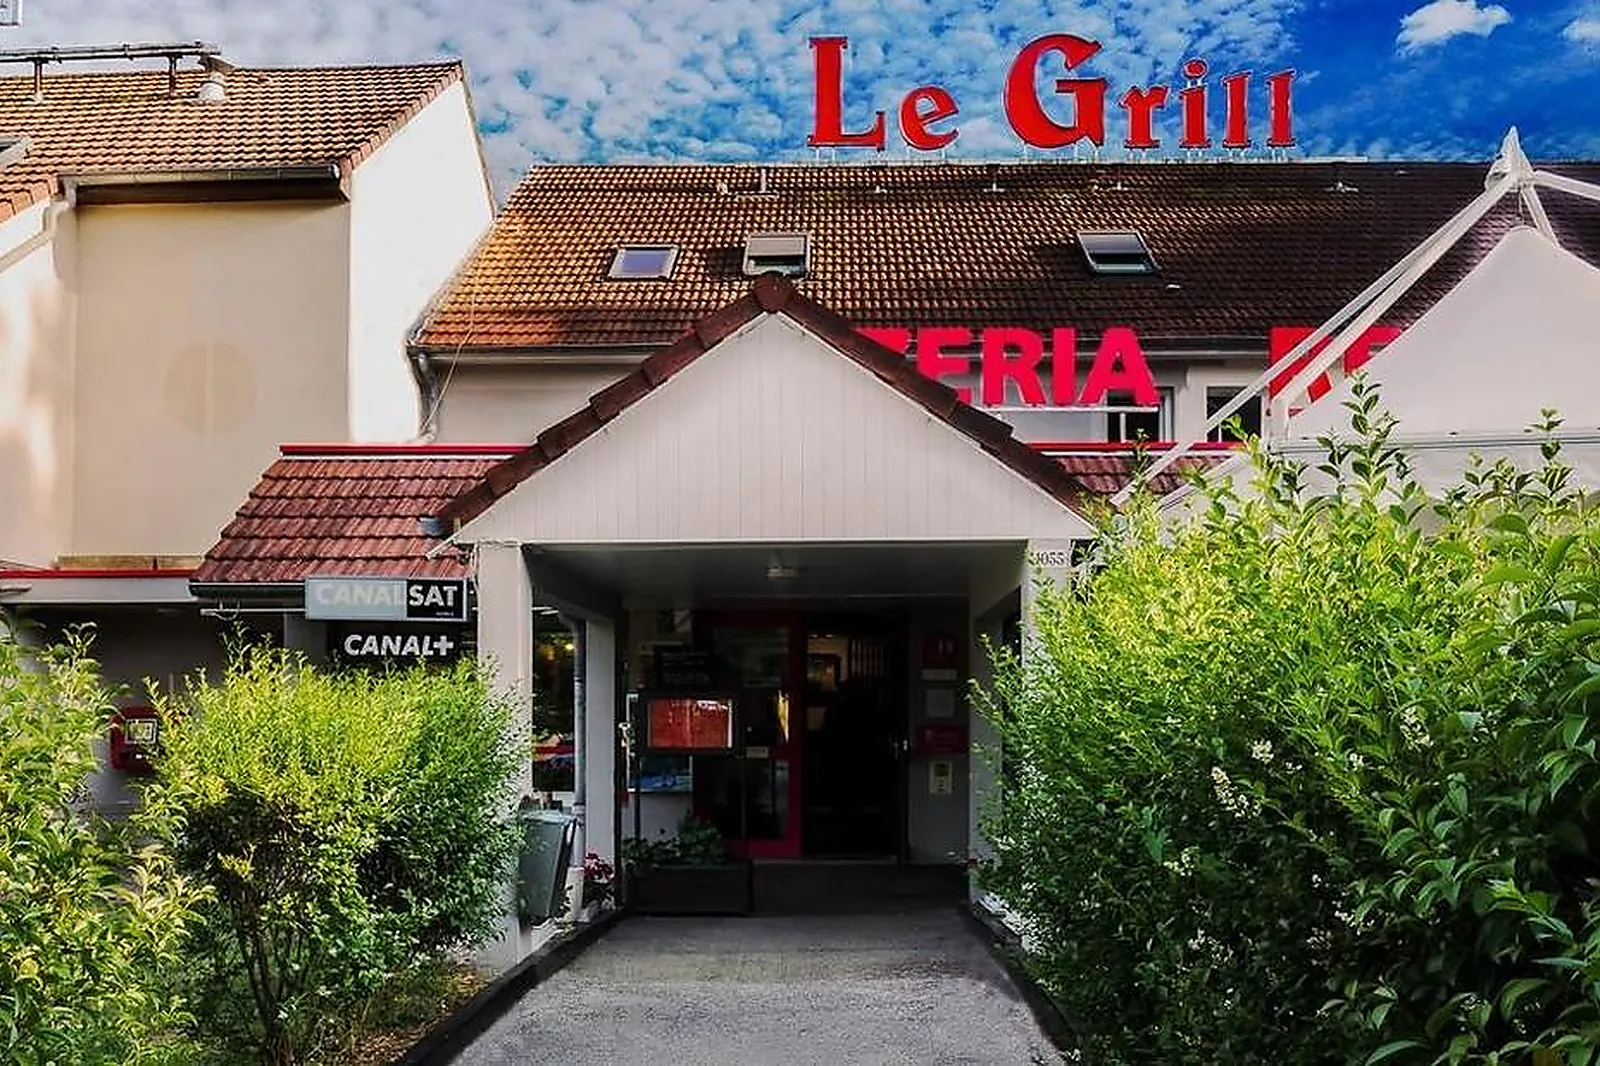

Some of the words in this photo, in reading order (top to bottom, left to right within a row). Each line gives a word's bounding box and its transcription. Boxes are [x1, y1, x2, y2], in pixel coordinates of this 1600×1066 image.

[806, 36, 960, 151] Le
[1003, 33, 1298, 151] Grill
[344, 634, 454, 656] CANAL+
